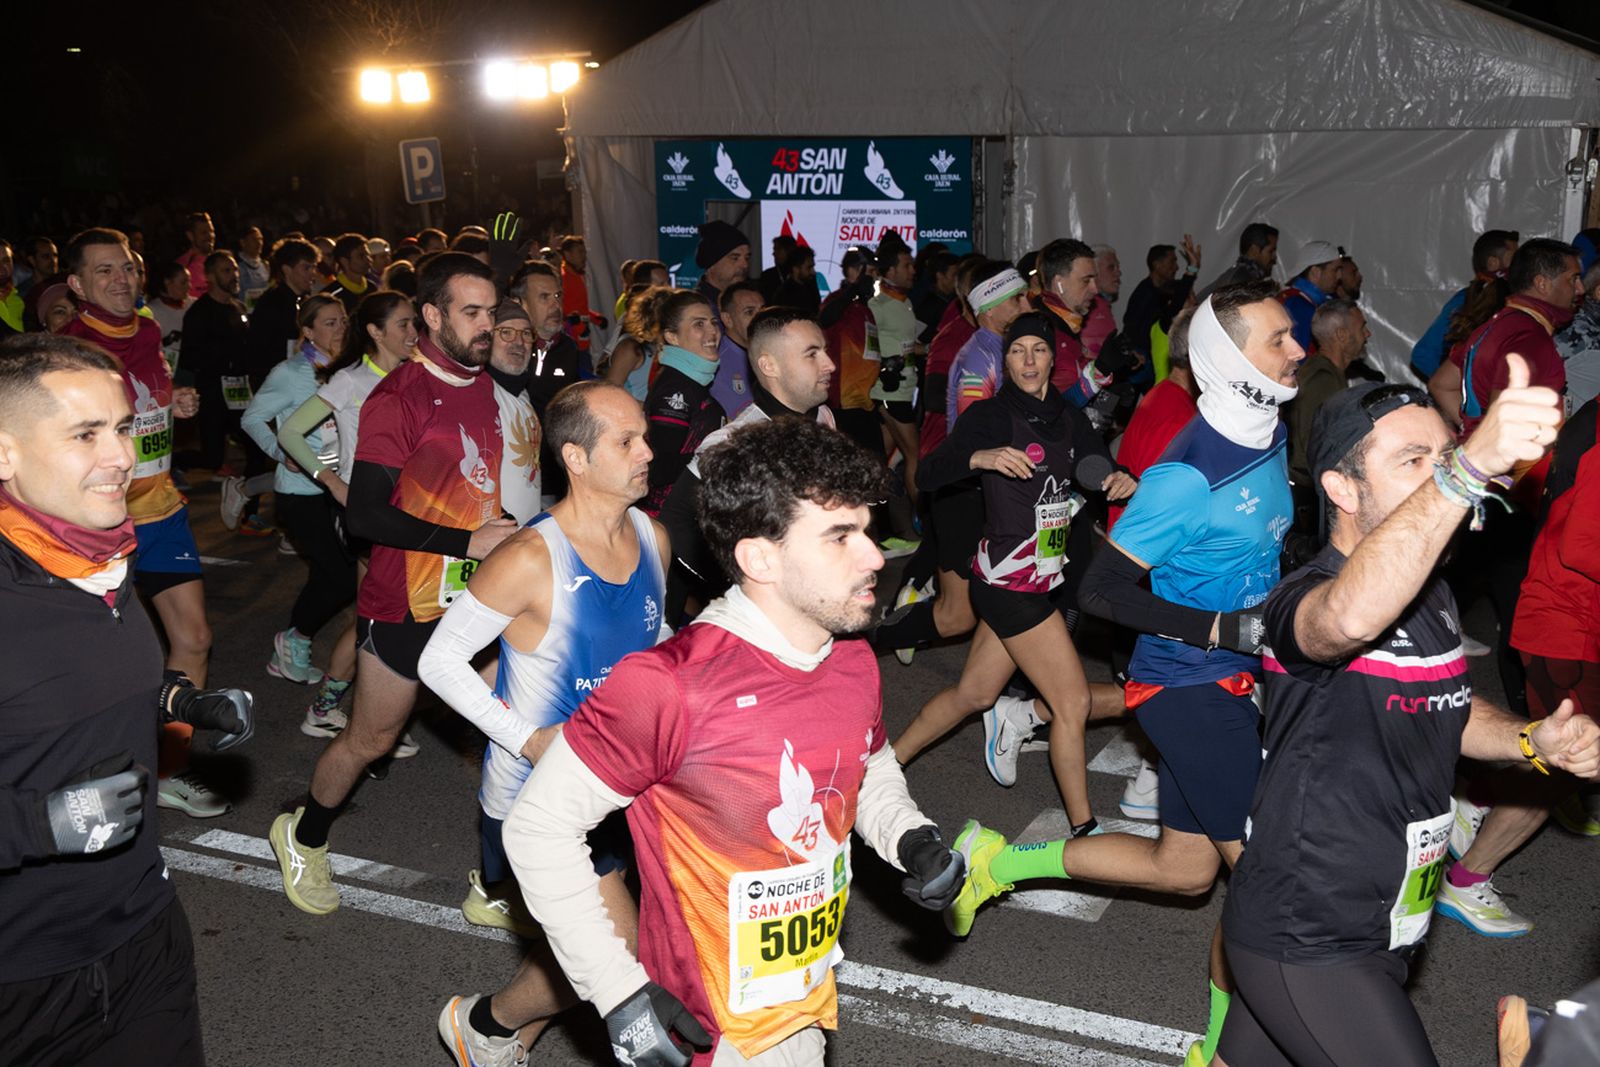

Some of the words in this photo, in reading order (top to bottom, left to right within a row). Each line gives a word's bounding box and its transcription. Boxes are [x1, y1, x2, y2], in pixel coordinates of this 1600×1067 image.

[410, 147, 434, 195] P
[726, 174, 738, 189] 43
[766, 167, 843, 195] ANTÓN
[876, 173, 891, 190] 43
[839, 225, 875, 241] SAN
[919, 228, 967, 238] calderón
[470, 463, 487, 485] 43
[1042, 520, 1054, 529] SAN
[66, 791, 88, 834] ANTÓN
[75, 788, 91, 816] SAN
[792, 815, 821, 851] 43
[1418, 851, 1435, 867] SAN
[767, 878, 811, 898] NOCHE
[814, 872, 825, 889] DE
[748, 901, 779, 919] SAN
[760, 895, 840, 962] 5053
